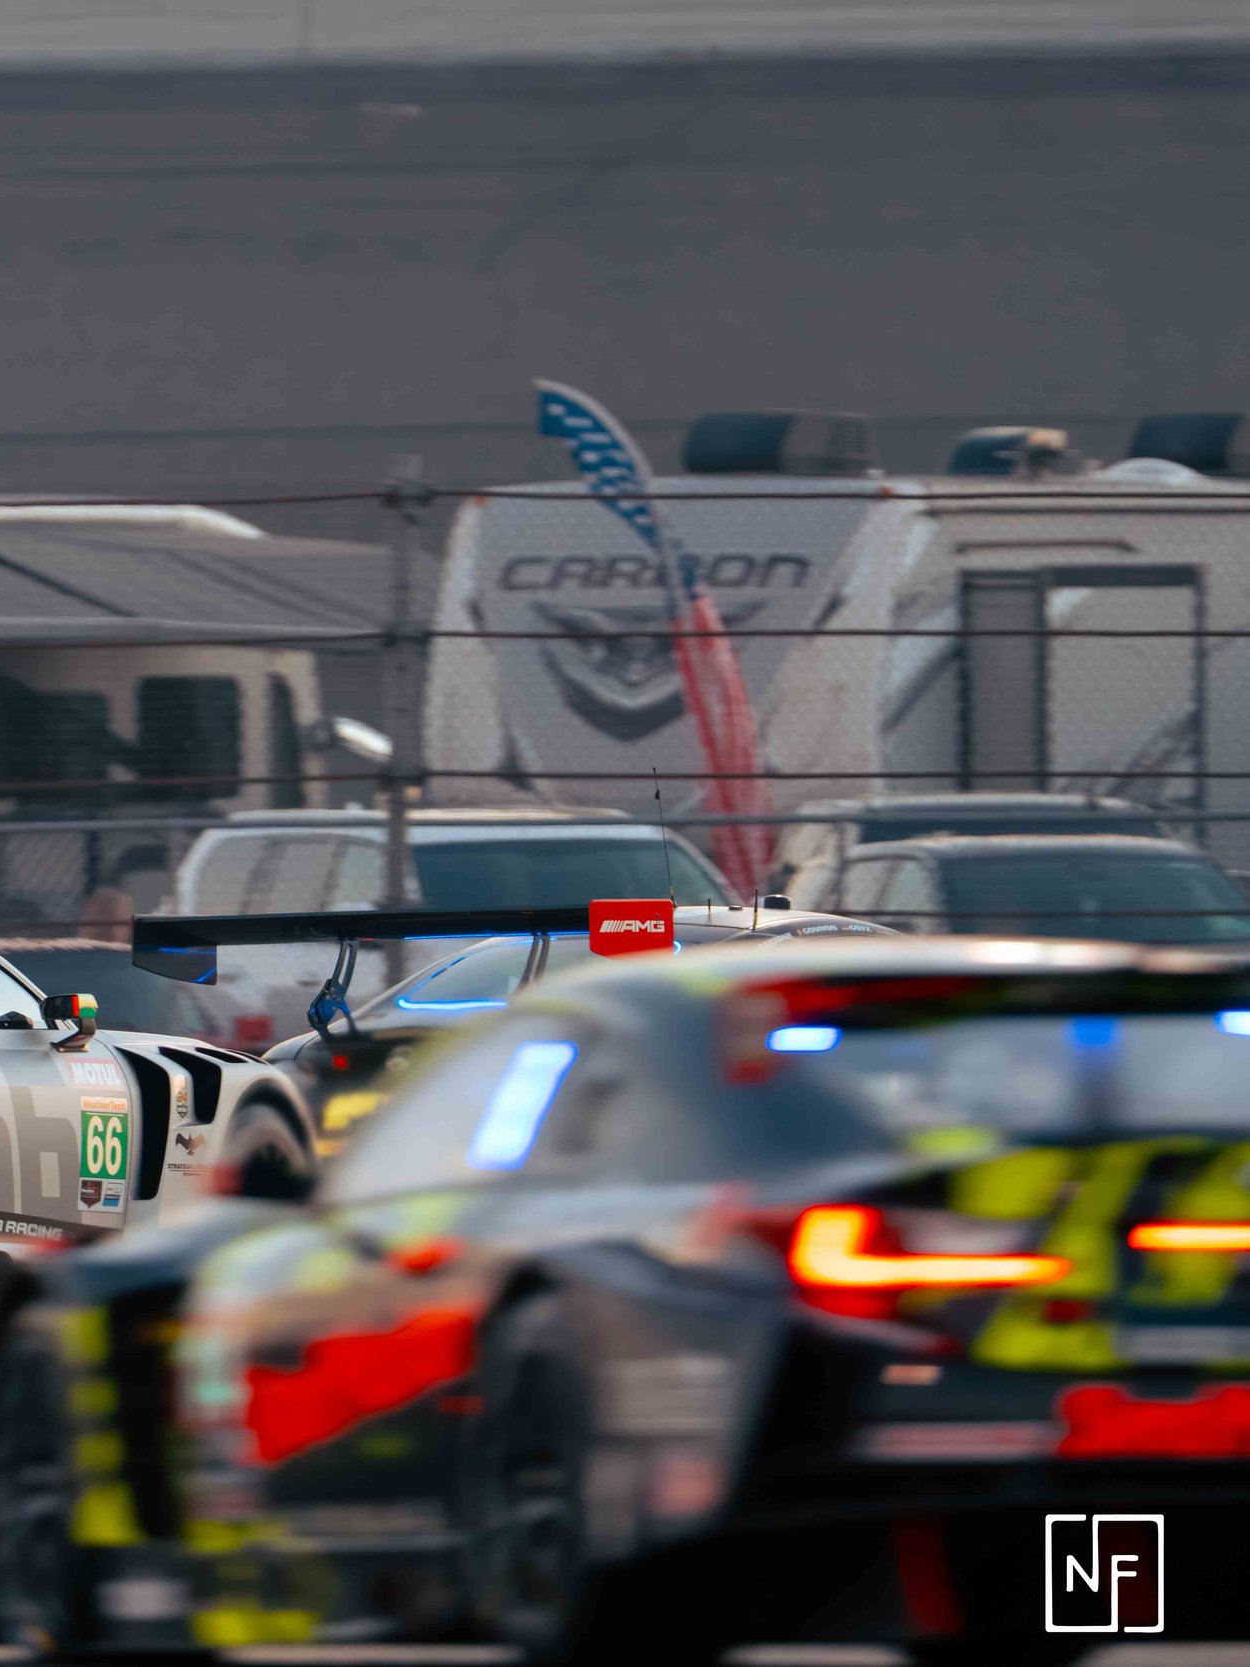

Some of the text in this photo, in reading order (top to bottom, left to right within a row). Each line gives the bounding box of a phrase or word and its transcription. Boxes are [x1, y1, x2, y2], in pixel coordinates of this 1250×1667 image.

[502, 554, 811, 591] CARON
[622, 920, 665, 933] AMG
[70, 1061, 122, 1086] MOTUL
[87, 1115, 122, 1176] 66
[5, 1220, 63, 1241] RACING
